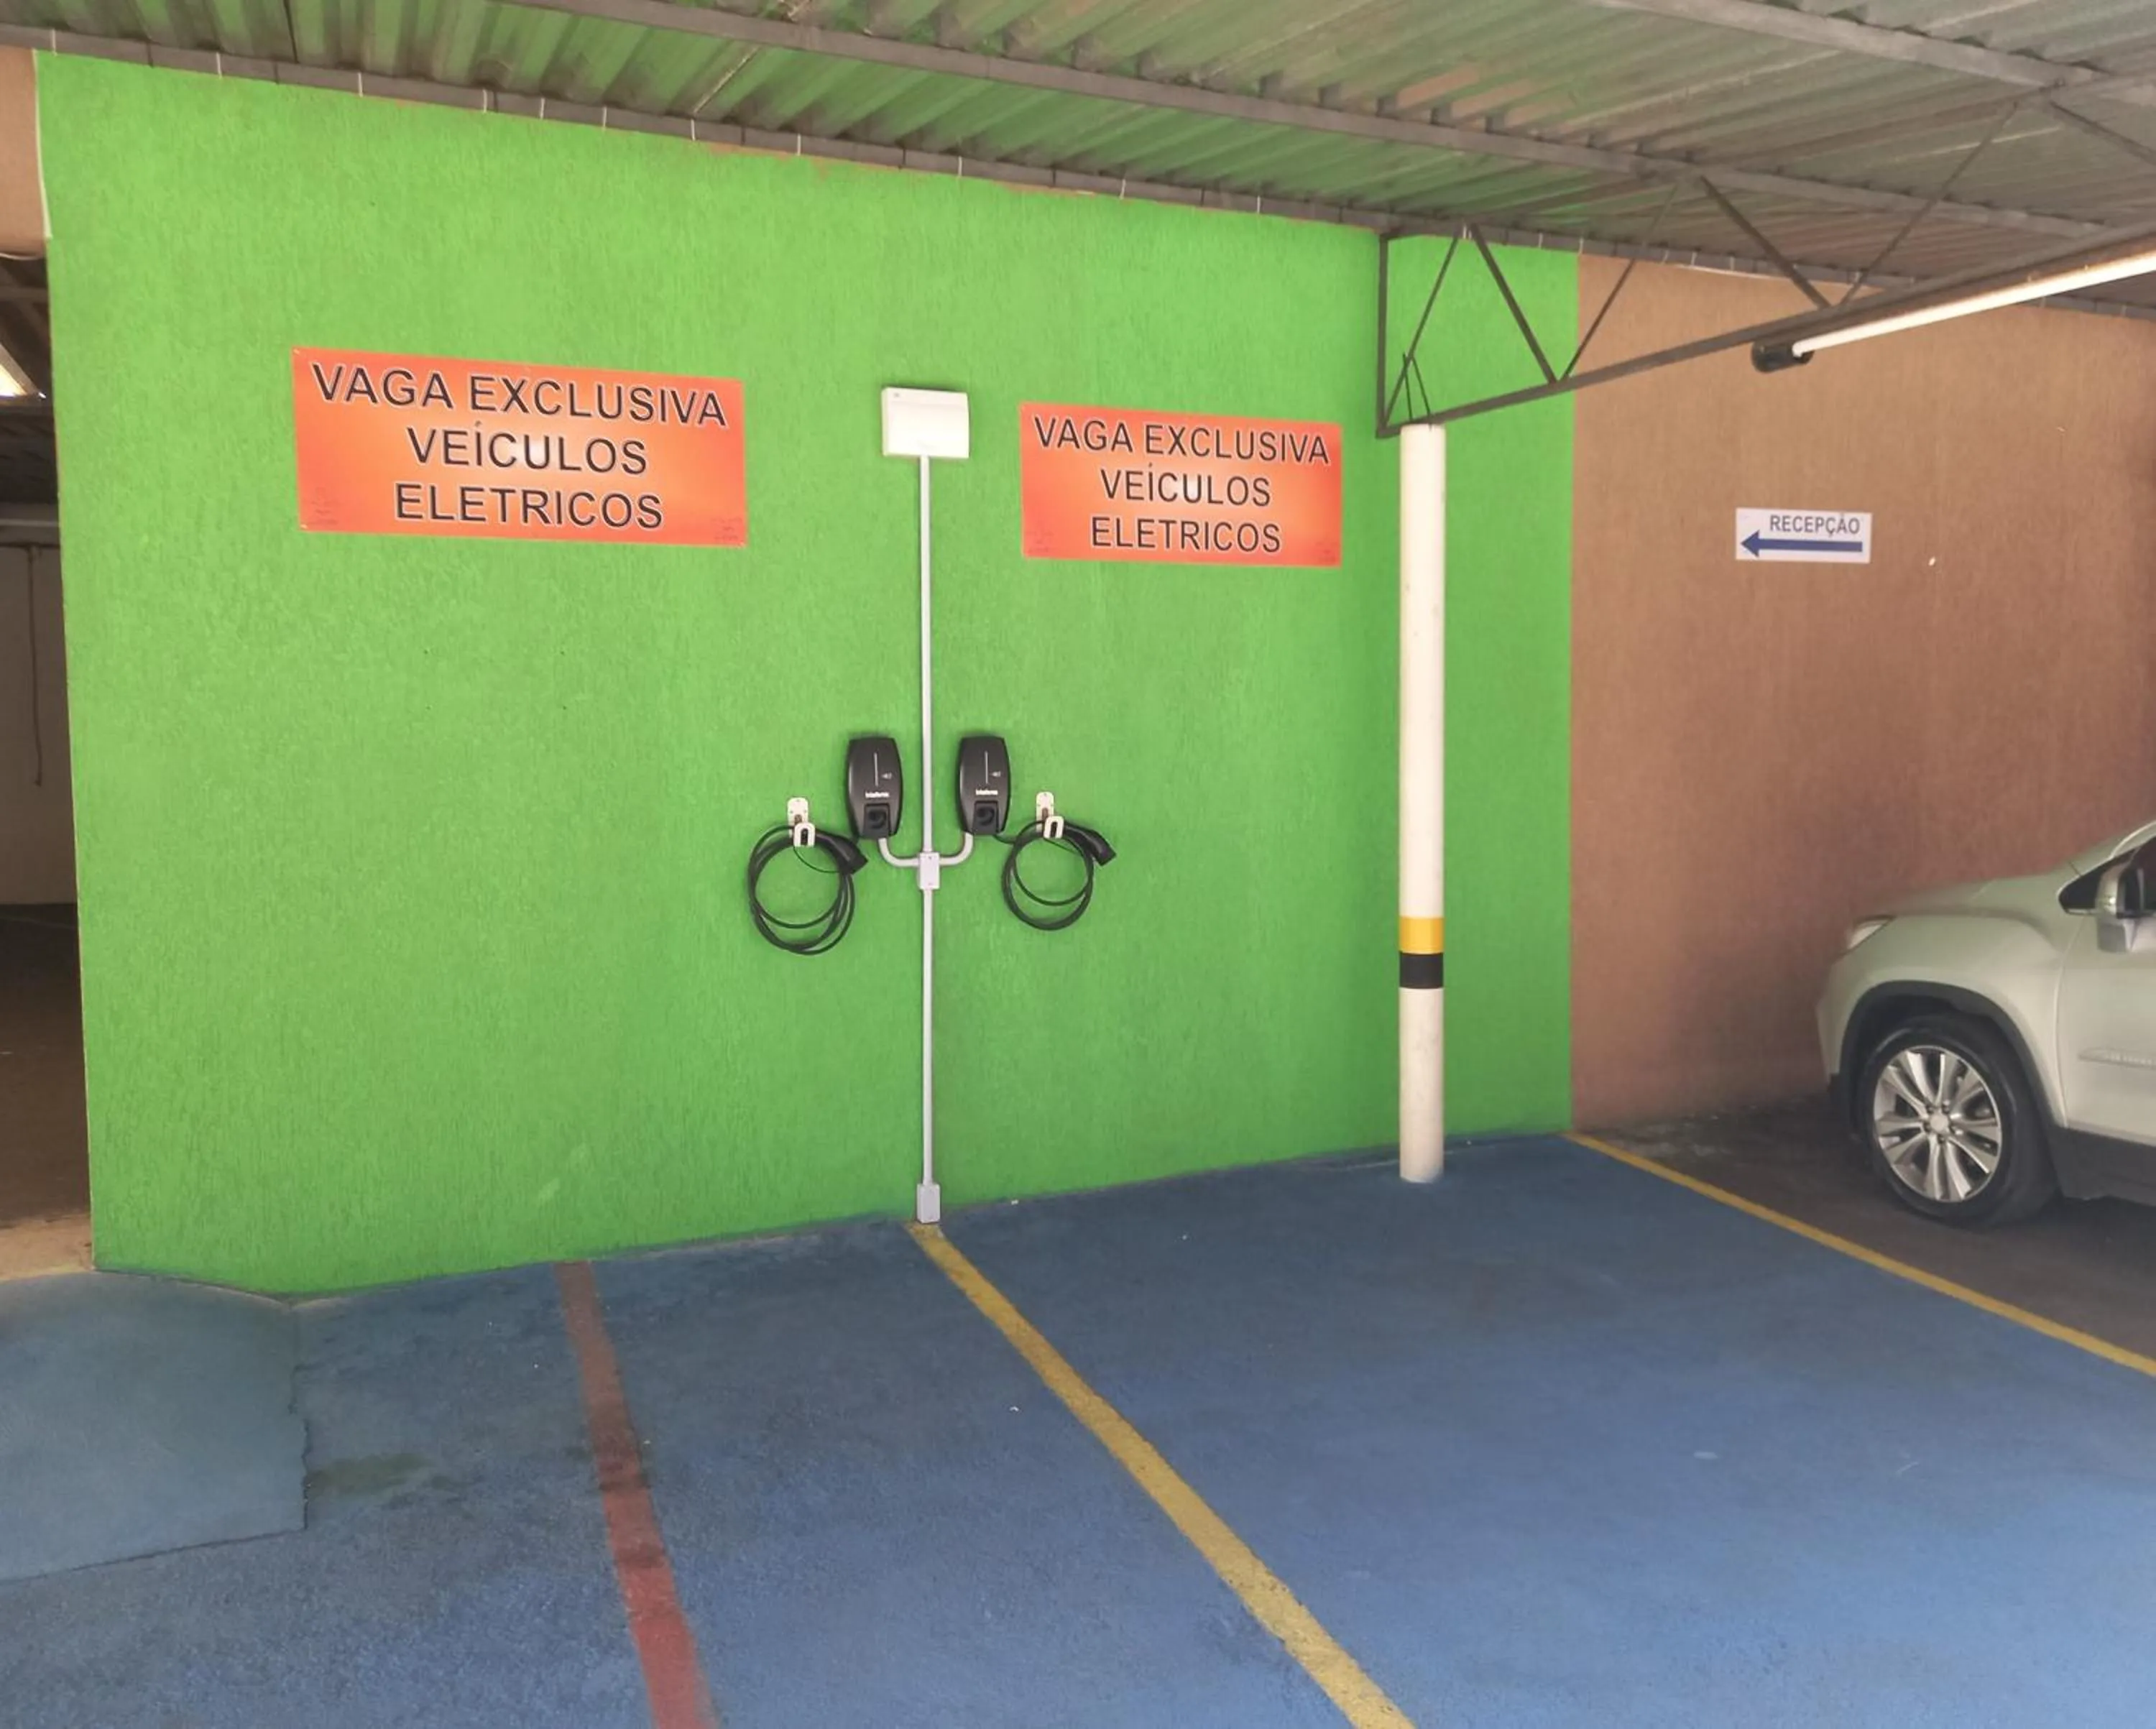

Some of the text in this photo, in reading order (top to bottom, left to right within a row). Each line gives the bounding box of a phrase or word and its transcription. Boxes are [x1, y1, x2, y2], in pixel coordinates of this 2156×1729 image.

[311, 363, 727, 427] VAGA EXCLUSIVA
[406, 420, 648, 476] VEÍCULOS
[1033, 415, 1330, 465] VAGA EXCLUSIVA
[395, 482, 663, 530] ELETRICOS
[1100, 462, 1271, 507] VEÍCULOS
[1091, 515, 1281, 553] ELETRICOS
[1769, 512, 1861, 537] RECEPÇÃO
